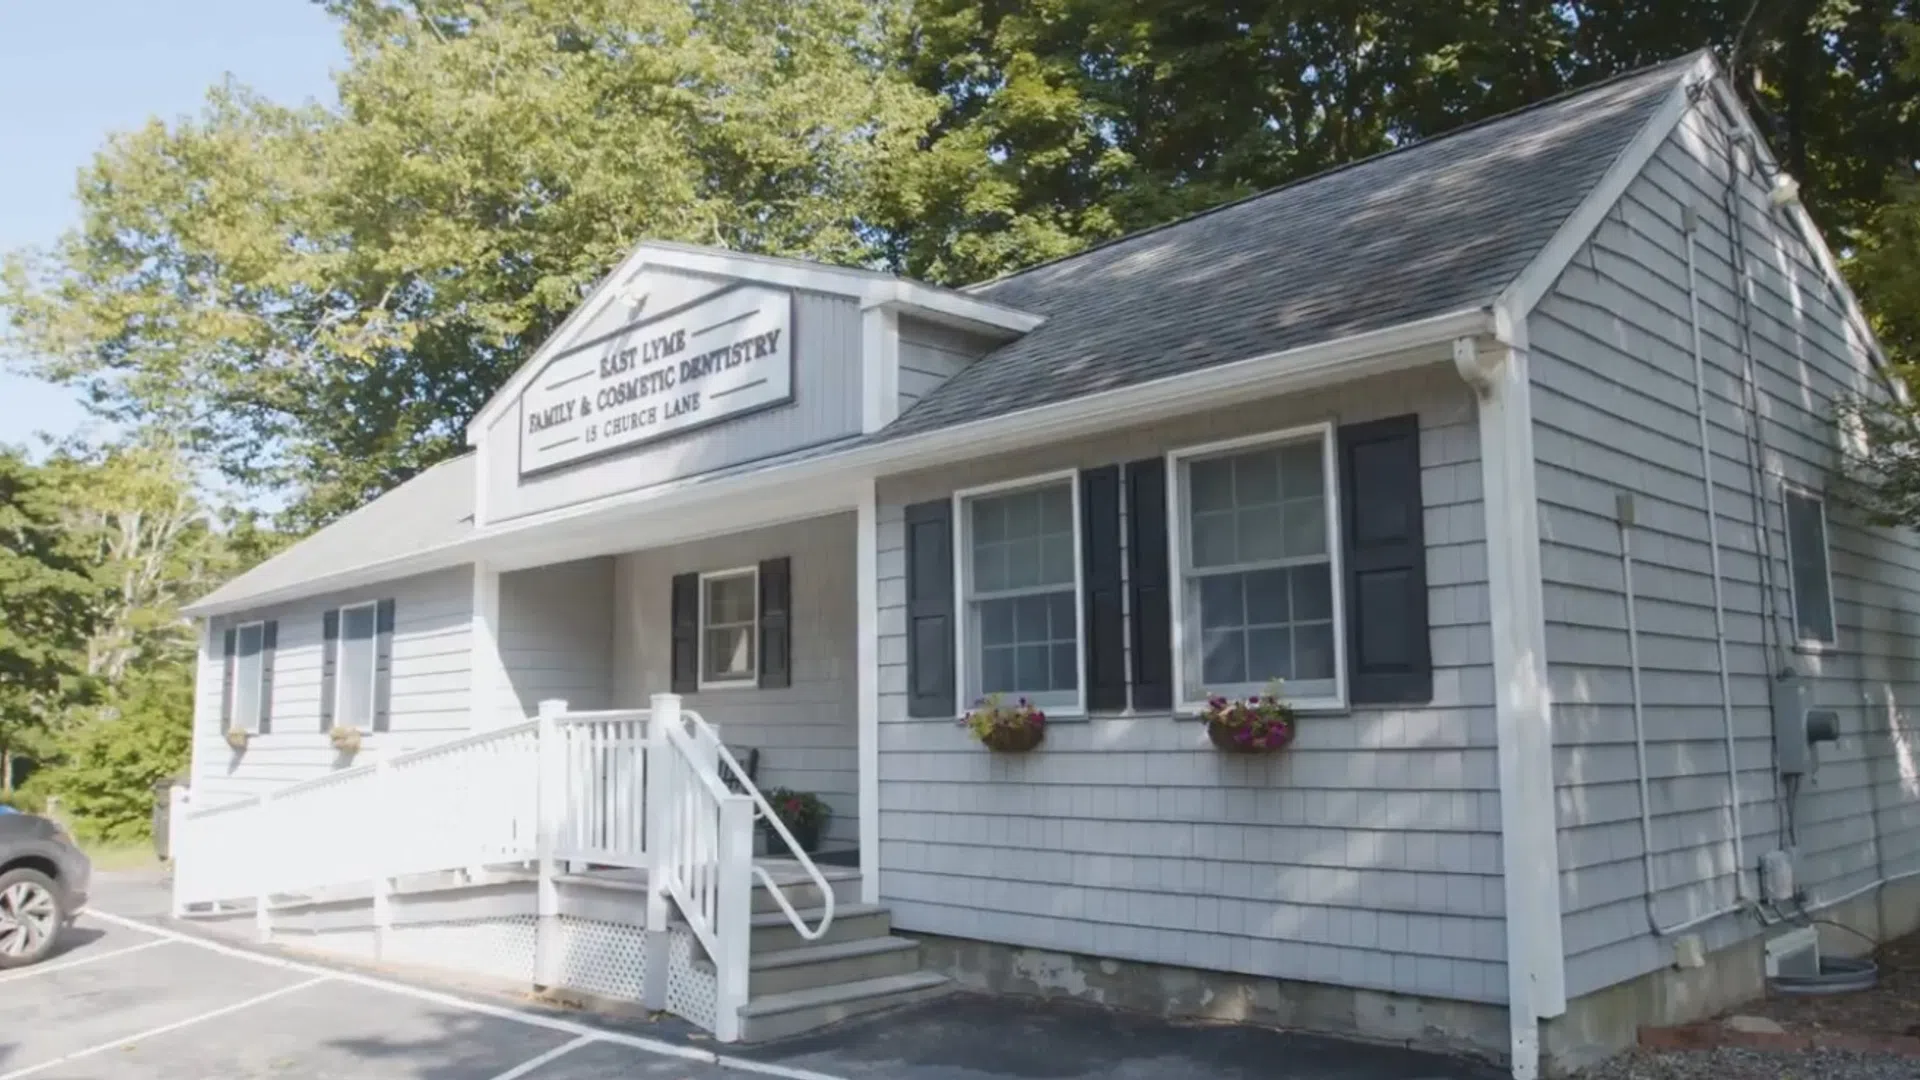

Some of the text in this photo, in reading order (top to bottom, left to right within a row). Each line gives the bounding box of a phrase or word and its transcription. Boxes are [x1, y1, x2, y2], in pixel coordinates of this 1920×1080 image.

[599, 329, 686, 380] EAST LYME
[529, 328, 782, 434] FAMILY & COSMETIC DENTISTRY
[585, 392, 700, 443] 15 CHURCH LANE
